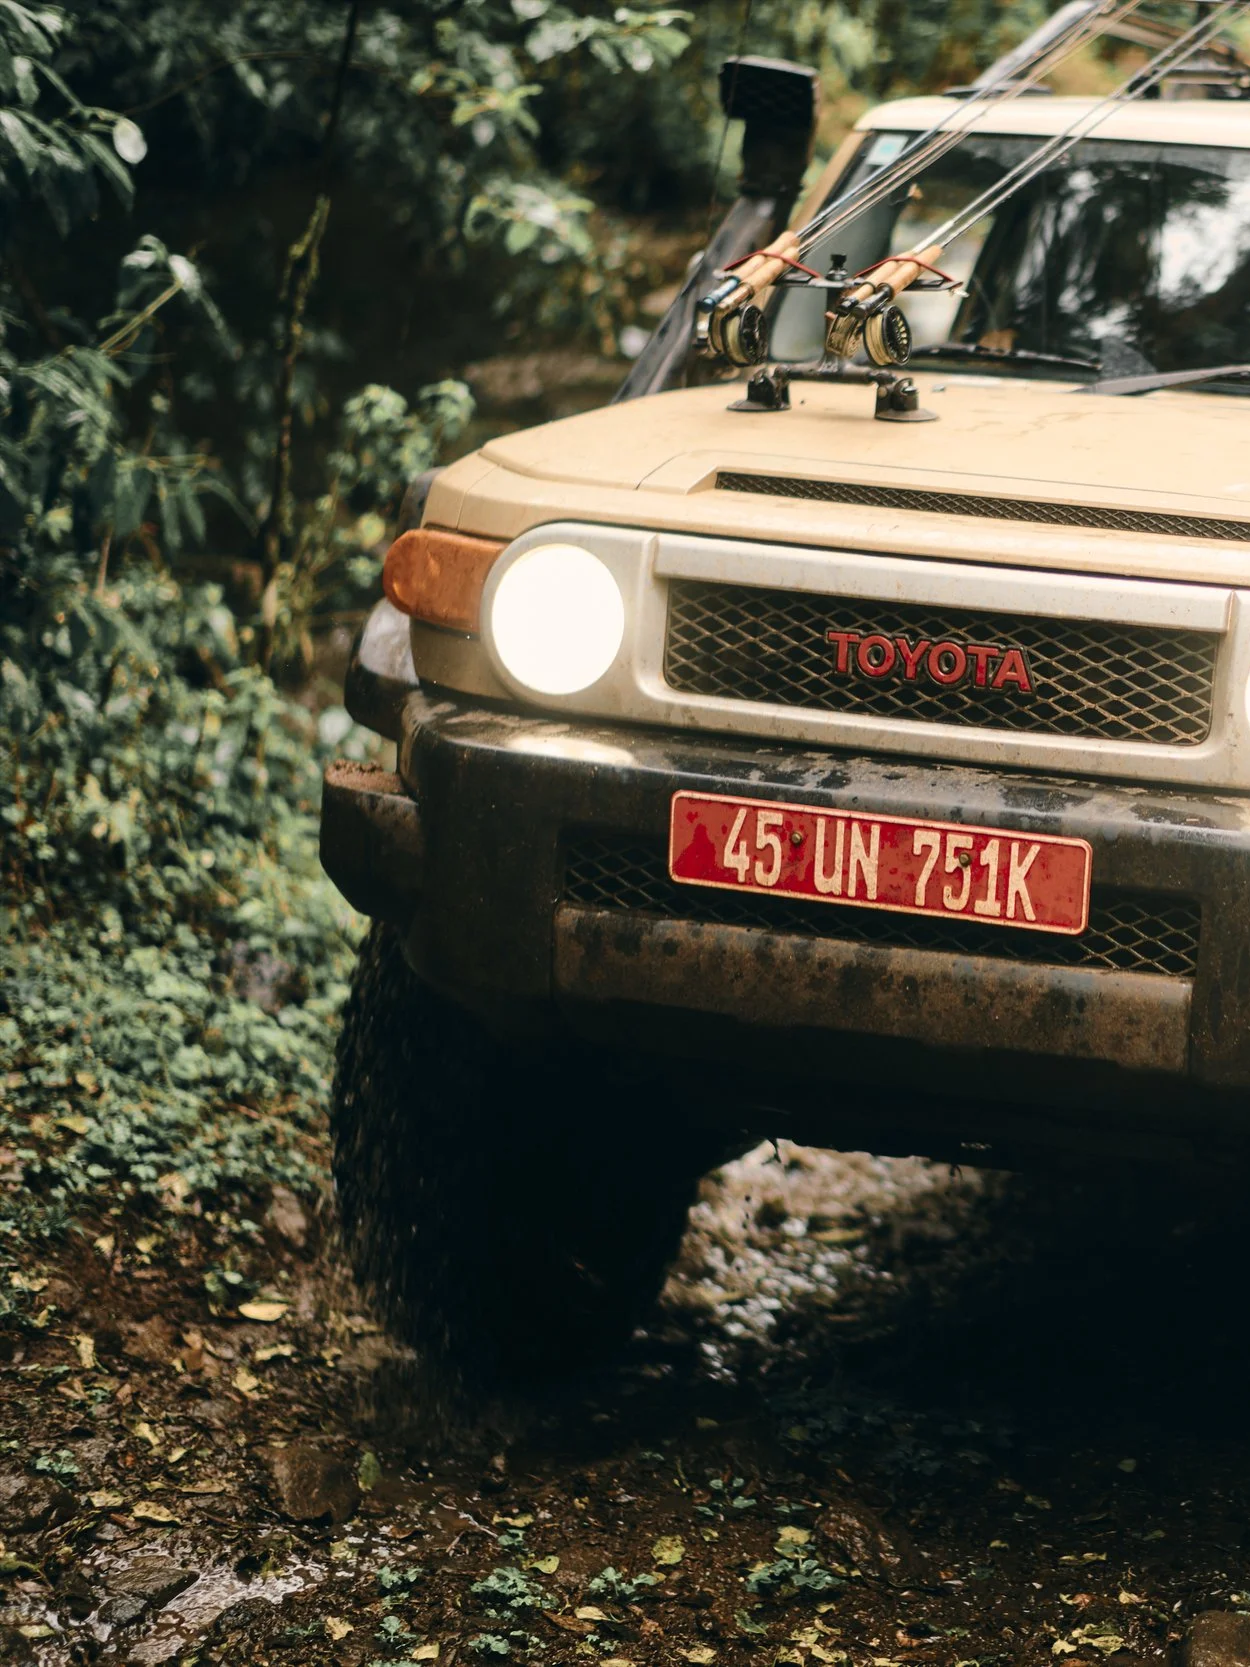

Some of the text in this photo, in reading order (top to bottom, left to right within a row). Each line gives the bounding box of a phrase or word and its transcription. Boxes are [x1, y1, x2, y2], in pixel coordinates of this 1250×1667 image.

[826, 630, 1034, 693] TOYOTA
[722, 808, 1041, 922] 45 UN 751K
